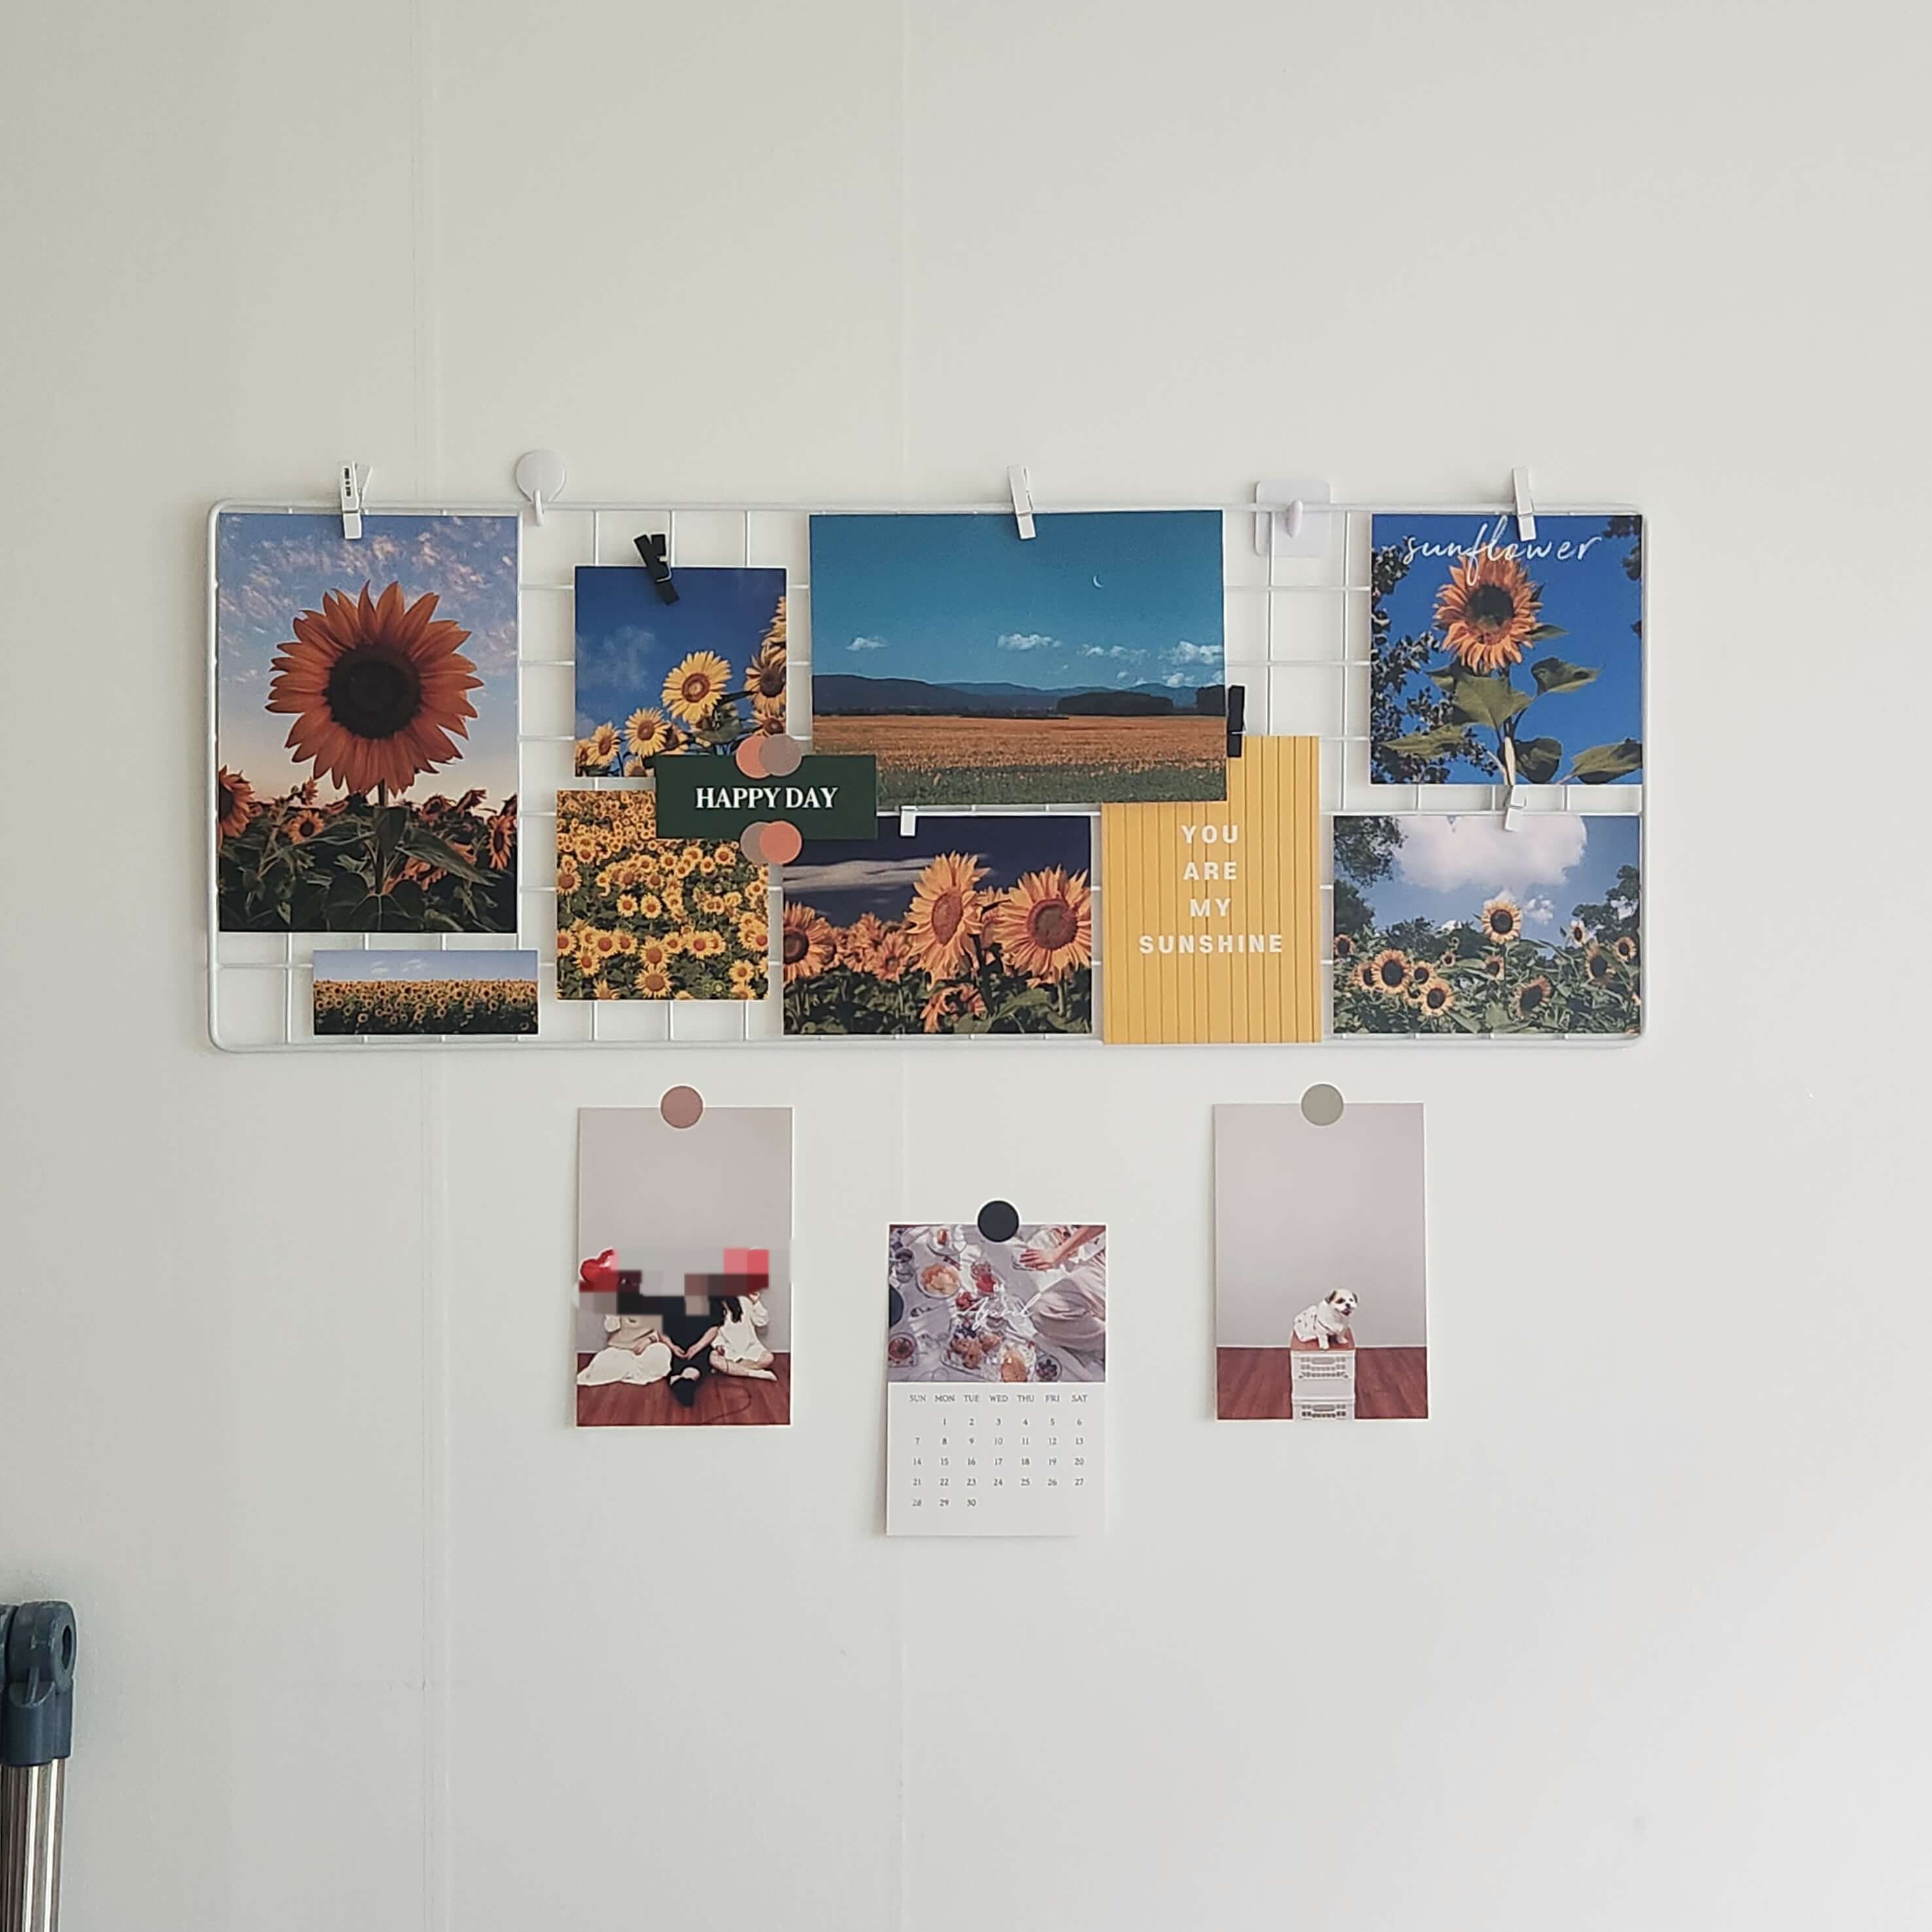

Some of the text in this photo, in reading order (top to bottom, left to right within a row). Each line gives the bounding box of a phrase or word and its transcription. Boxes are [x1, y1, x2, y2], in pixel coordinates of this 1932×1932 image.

[1402, 514, 1602, 586] sunflower
[695, 786, 838, 809] HAPPY DAY
[1181, 824, 1239, 845] YOU
[1182, 861, 1237, 881] ARE
[1189, 897, 1231, 918] MY
[1139, 933, 1283, 954] SUNSHINE
[908, 1394, 1089, 1404] SUN MON TUE WED THU FRI SAT
[994, 1437, 1003, 1445] 10
[1022, 1437, 1029, 1445] 11
[1048, 1437, 1057, 1445] 12
[1075, 1437, 1084, 1445] 13
[940, 1457, 949, 1466] 15
[995, 1457, 1003, 1466] 17
[1048, 1457, 1057, 1466] 19
[1074, 1457, 1084, 1466] 20
[913, 1477, 1084, 1487] 21 22 23 24 25 26 27
[939, 1498, 950, 1507] 29
[966, 1498, 976, 1507] 30
